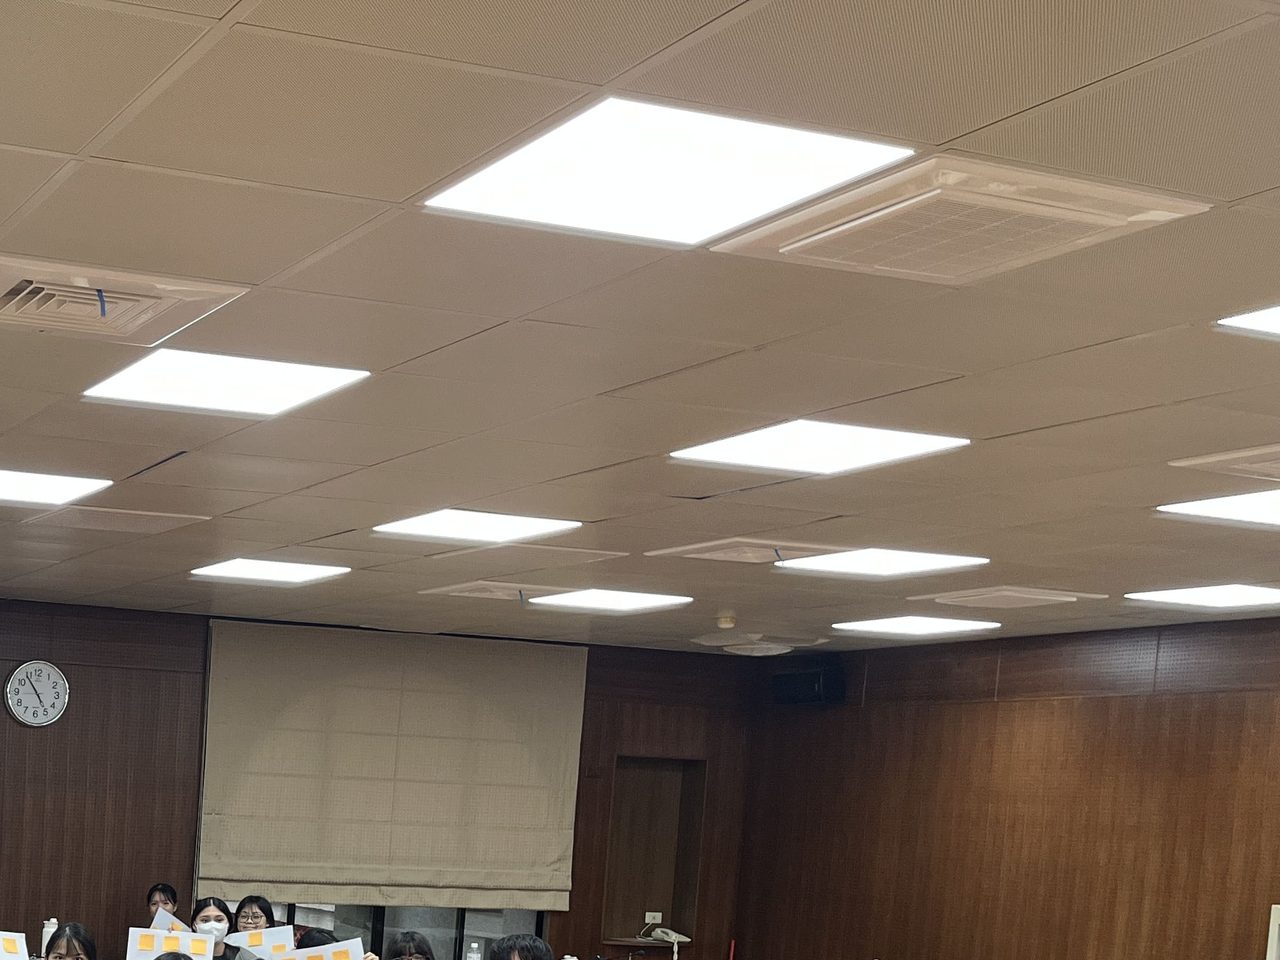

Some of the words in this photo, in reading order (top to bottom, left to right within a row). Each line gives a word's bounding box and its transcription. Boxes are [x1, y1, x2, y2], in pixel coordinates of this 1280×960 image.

[34, 668, 42, 678] 12
[18, 678, 26, 686] 10
[14, 688, 20, 696] 9
[54, 692, 60, 700] 3
[16, 698, 22, 706] 8
[32, 710, 38, 718] 6
[42, 708, 48, 716] 5
